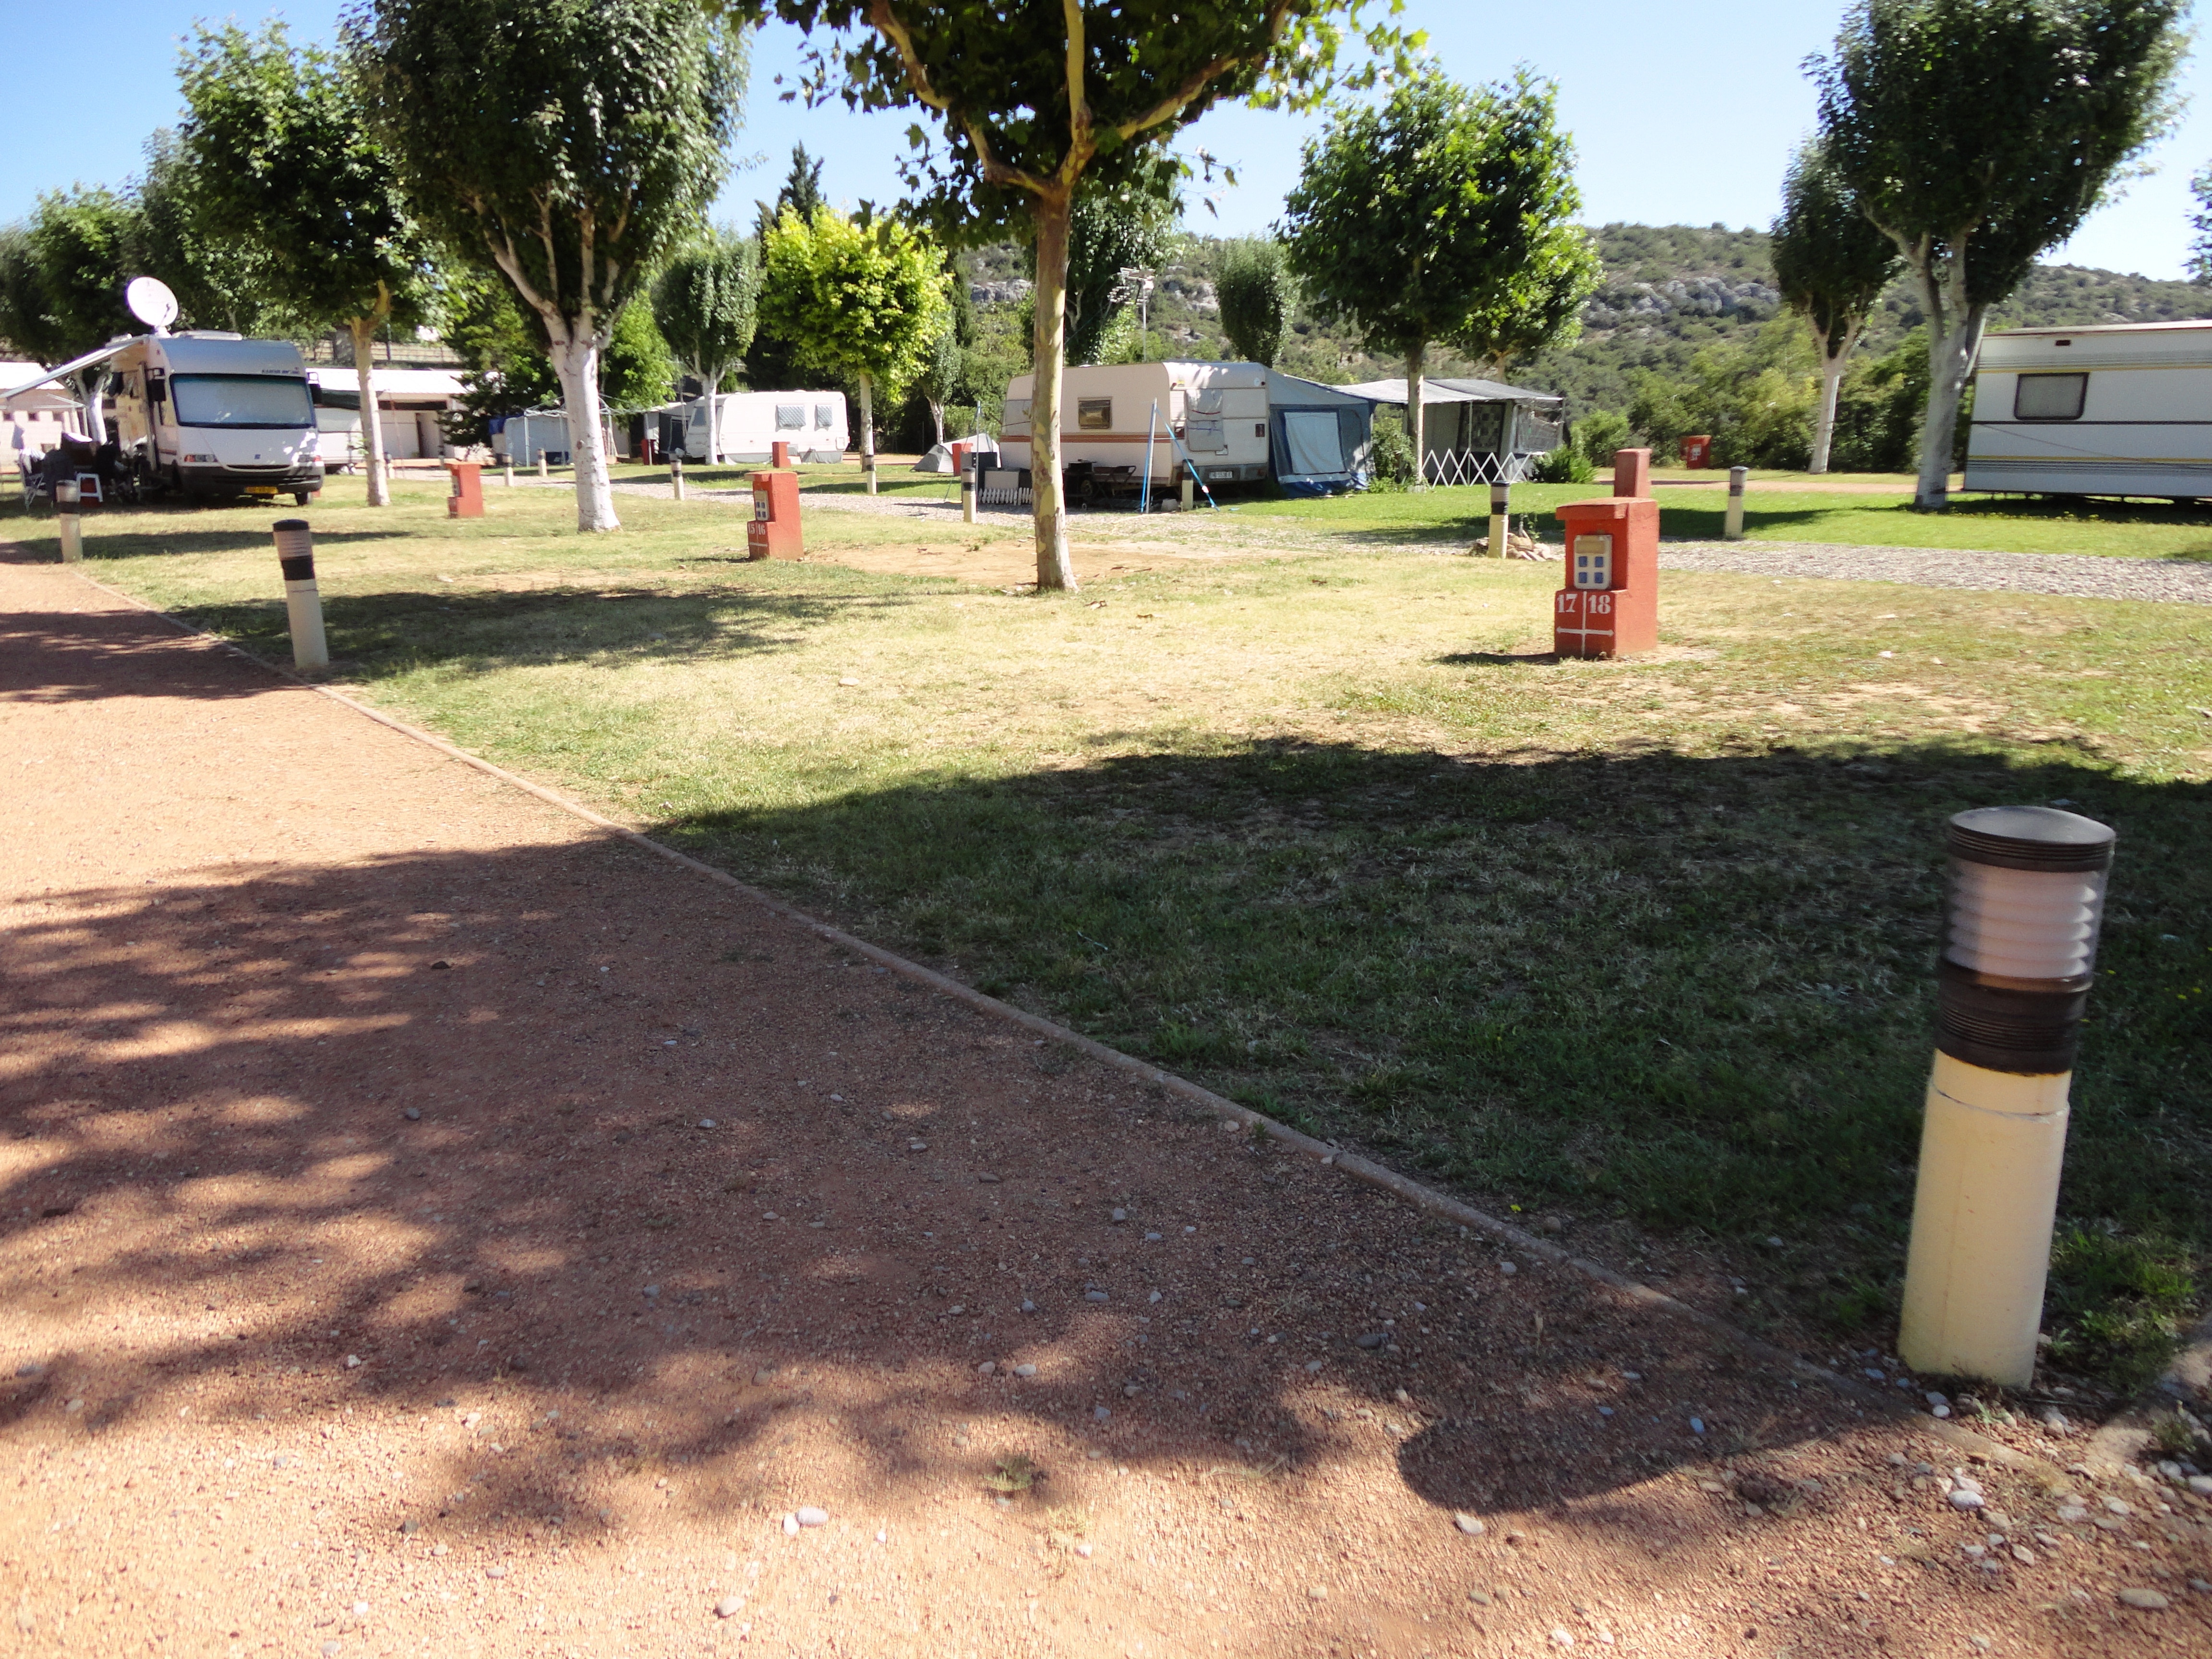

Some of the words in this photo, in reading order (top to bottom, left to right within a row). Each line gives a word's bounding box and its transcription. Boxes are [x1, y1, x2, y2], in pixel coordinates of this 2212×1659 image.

[748, 523, 755, 534] 15
[758, 524, 766, 535] 16
[1557, 593, 1577, 613] 17
[1588, 595, 1611, 614] 18
